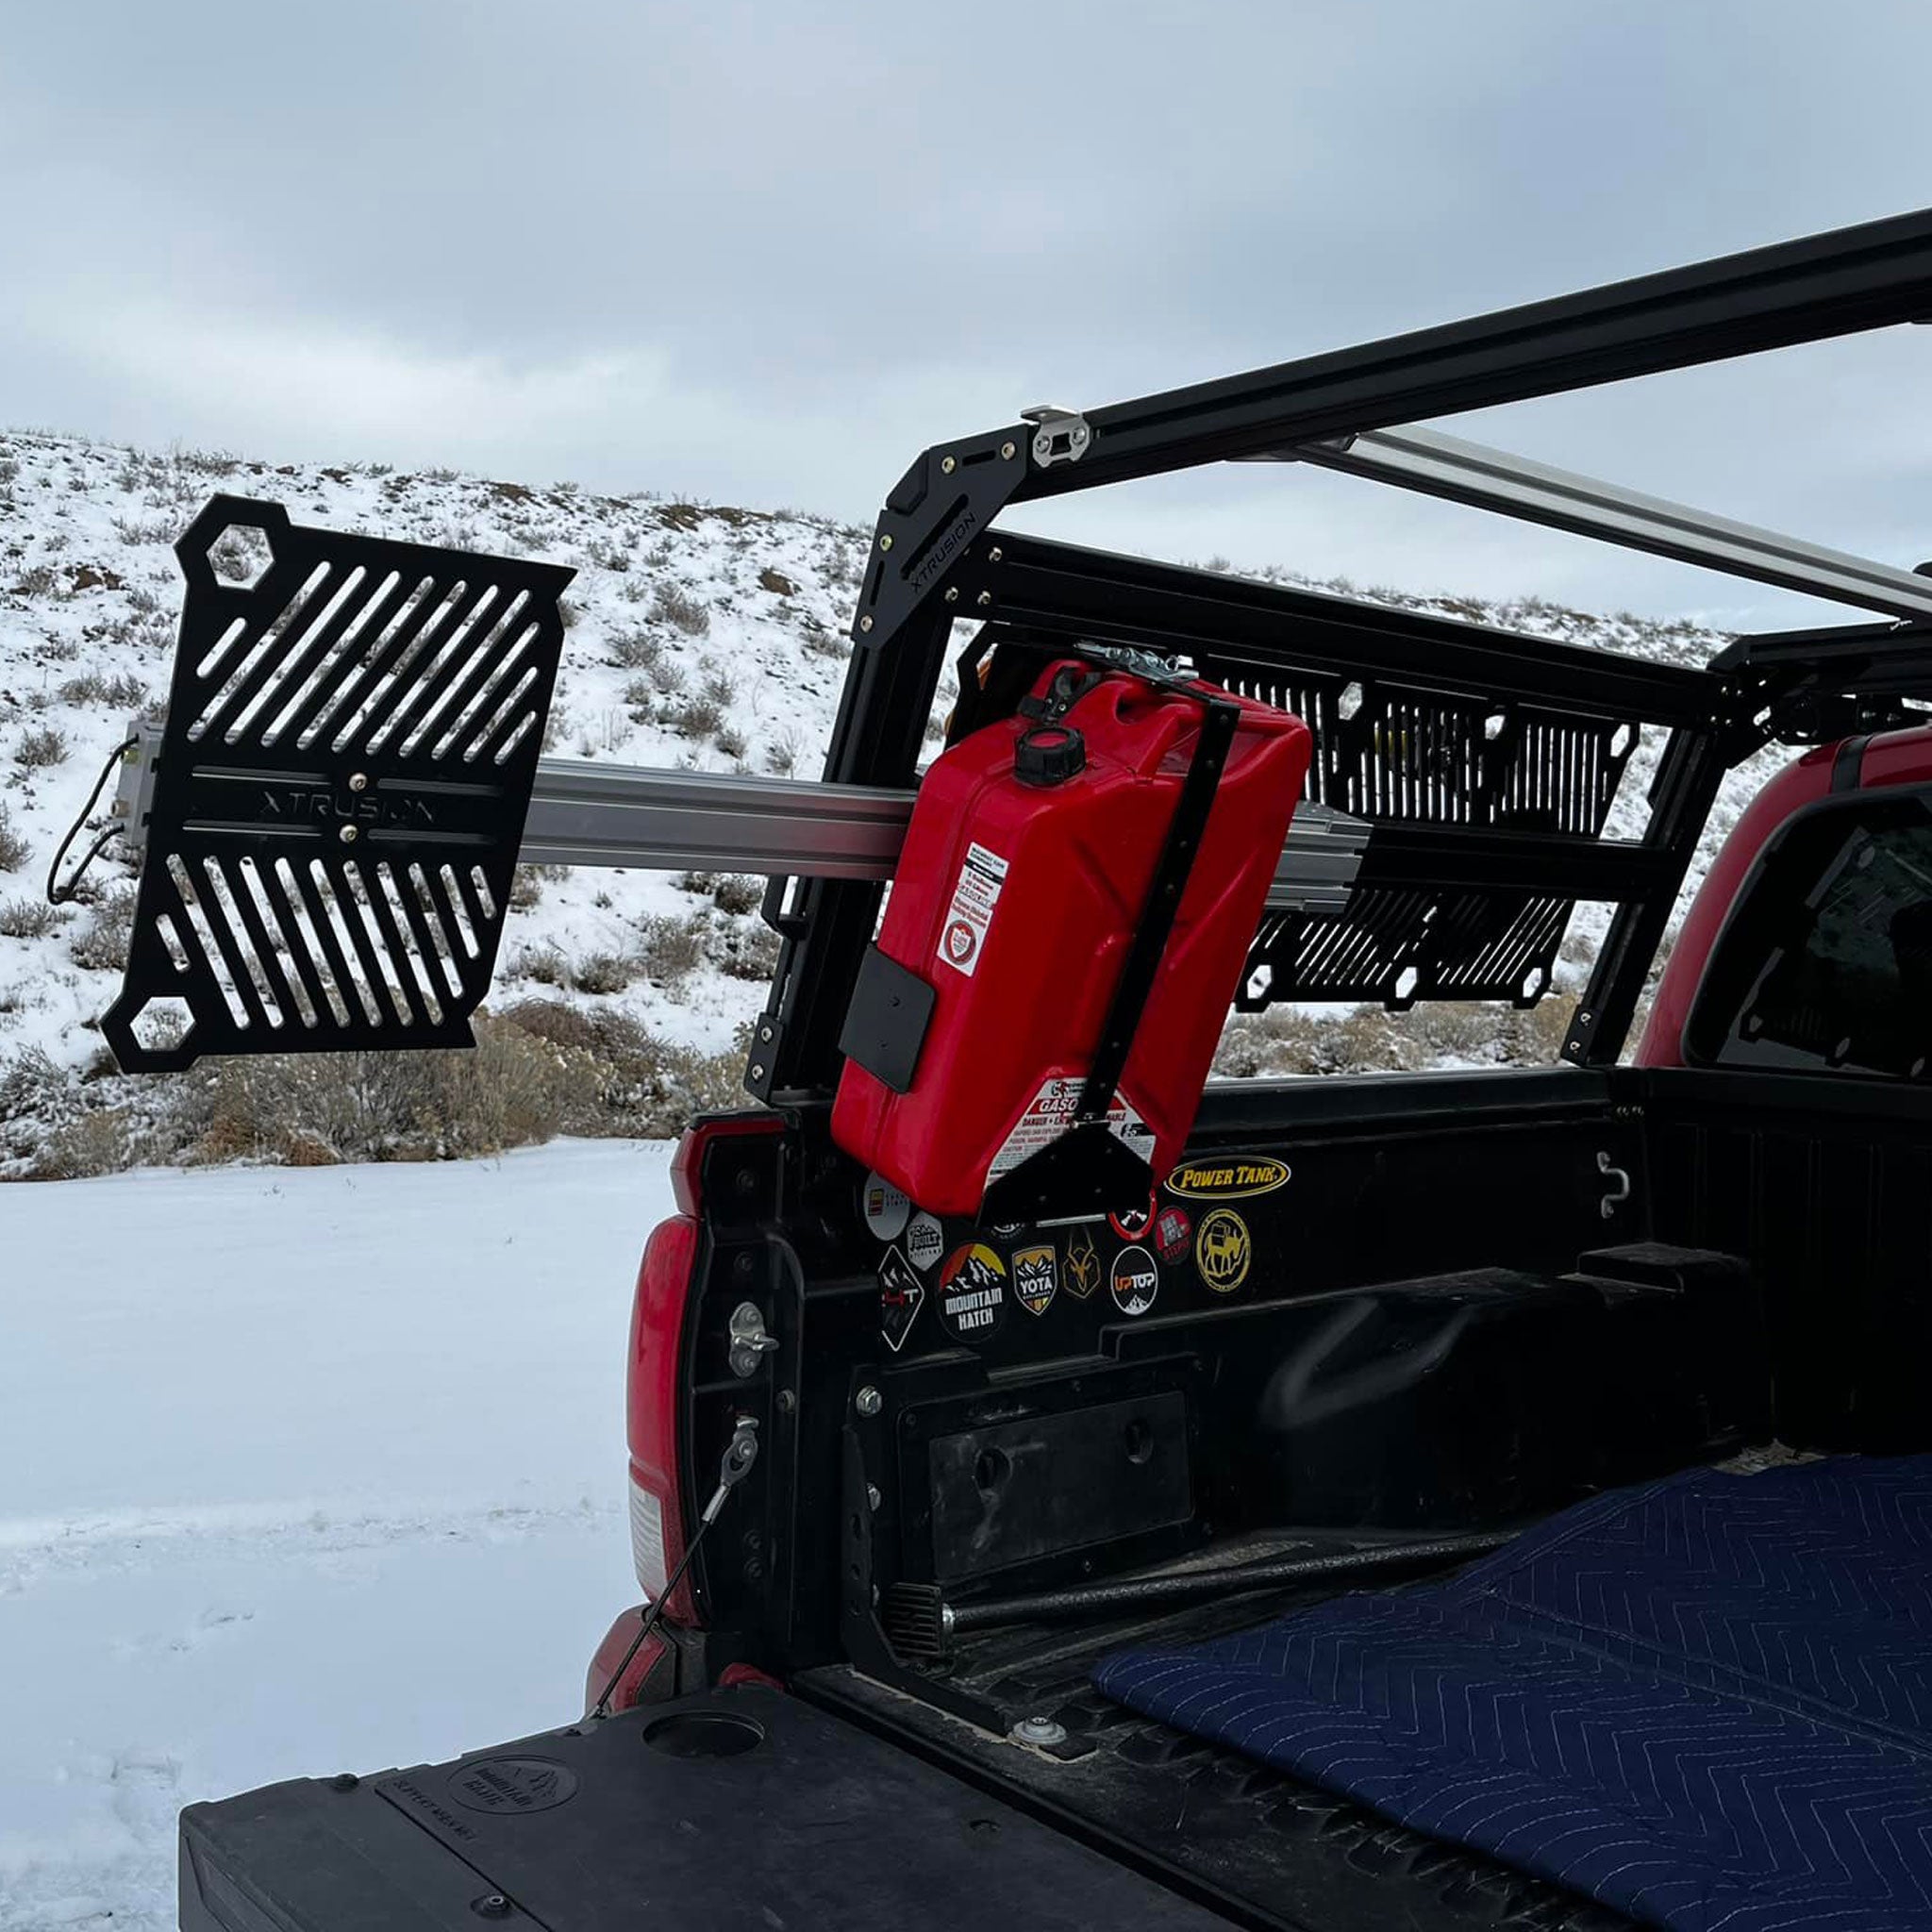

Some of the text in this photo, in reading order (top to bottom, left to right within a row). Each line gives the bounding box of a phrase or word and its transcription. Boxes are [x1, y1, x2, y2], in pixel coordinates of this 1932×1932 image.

[910, 513, 975, 593] XTRUSION
[259, 790, 434, 824] XTRUSION
[1039, 1098, 1078, 1113] GASO
[1179, 1168, 1234, 1189] POWER
[1020, 1275, 1053, 1294] YOTA
[1114, 1271, 1155, 1292] UPTOP
[945, 1287, 1003, 1315] MOUNTAIN
[958, 1307, 994, 1331] HATCH
